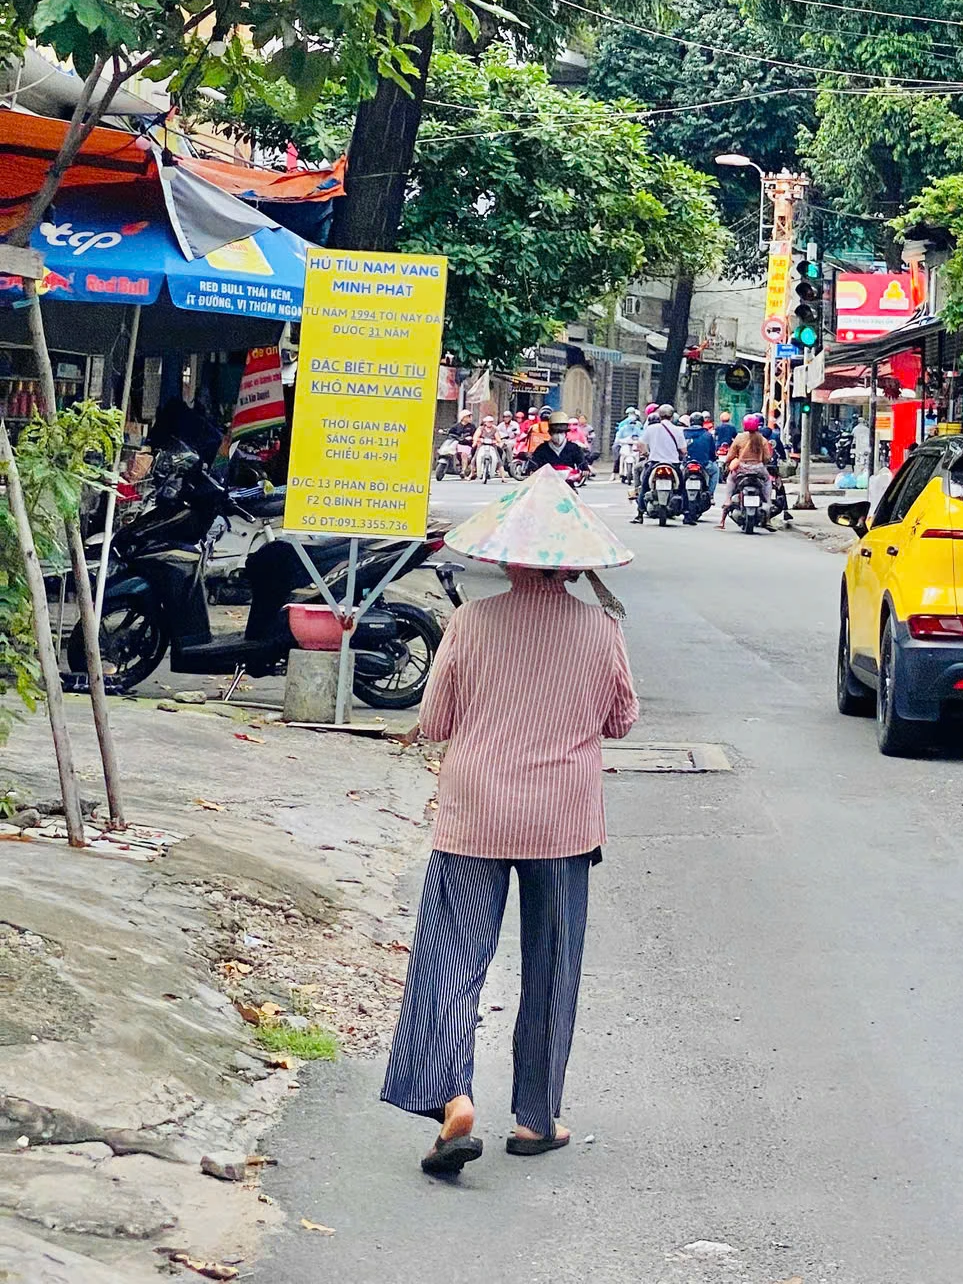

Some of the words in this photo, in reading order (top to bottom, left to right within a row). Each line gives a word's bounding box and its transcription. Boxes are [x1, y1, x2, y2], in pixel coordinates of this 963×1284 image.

[363, 262, 396, 274] NAM
[400, 265, 439, 277] VANG
[86, 274, 117, 293] Red
[117, 276, 149, 296] Bull
[200, 281, 218, 293] RED
[221, 283, 245, 295] BULL
[247, 285, 268, 298] THÁI
[332, 281, 371, 293] MINH
[187, 292, 196, 305] ÍT
[249, 300, 275, 313] THƠM
[351, 310, 376, 321] 1994
[400, 313, 422, 323] NAY
[368, 326, 380, 337] 31
[311, 378, 342, 393] KHÔ
[346, 382, 379, 395] NAM
[383, 385, 422, 398] VANG
[352, 420, 380, 431] GIAN
[359, 436, 399, 447] 6H-11H
[363, 452, 398, 462] 4H-9H
[318, 478, 330, 489] 13
[334, 480, 366, 491] PHAN
[307, 496, 319, 505] F2
